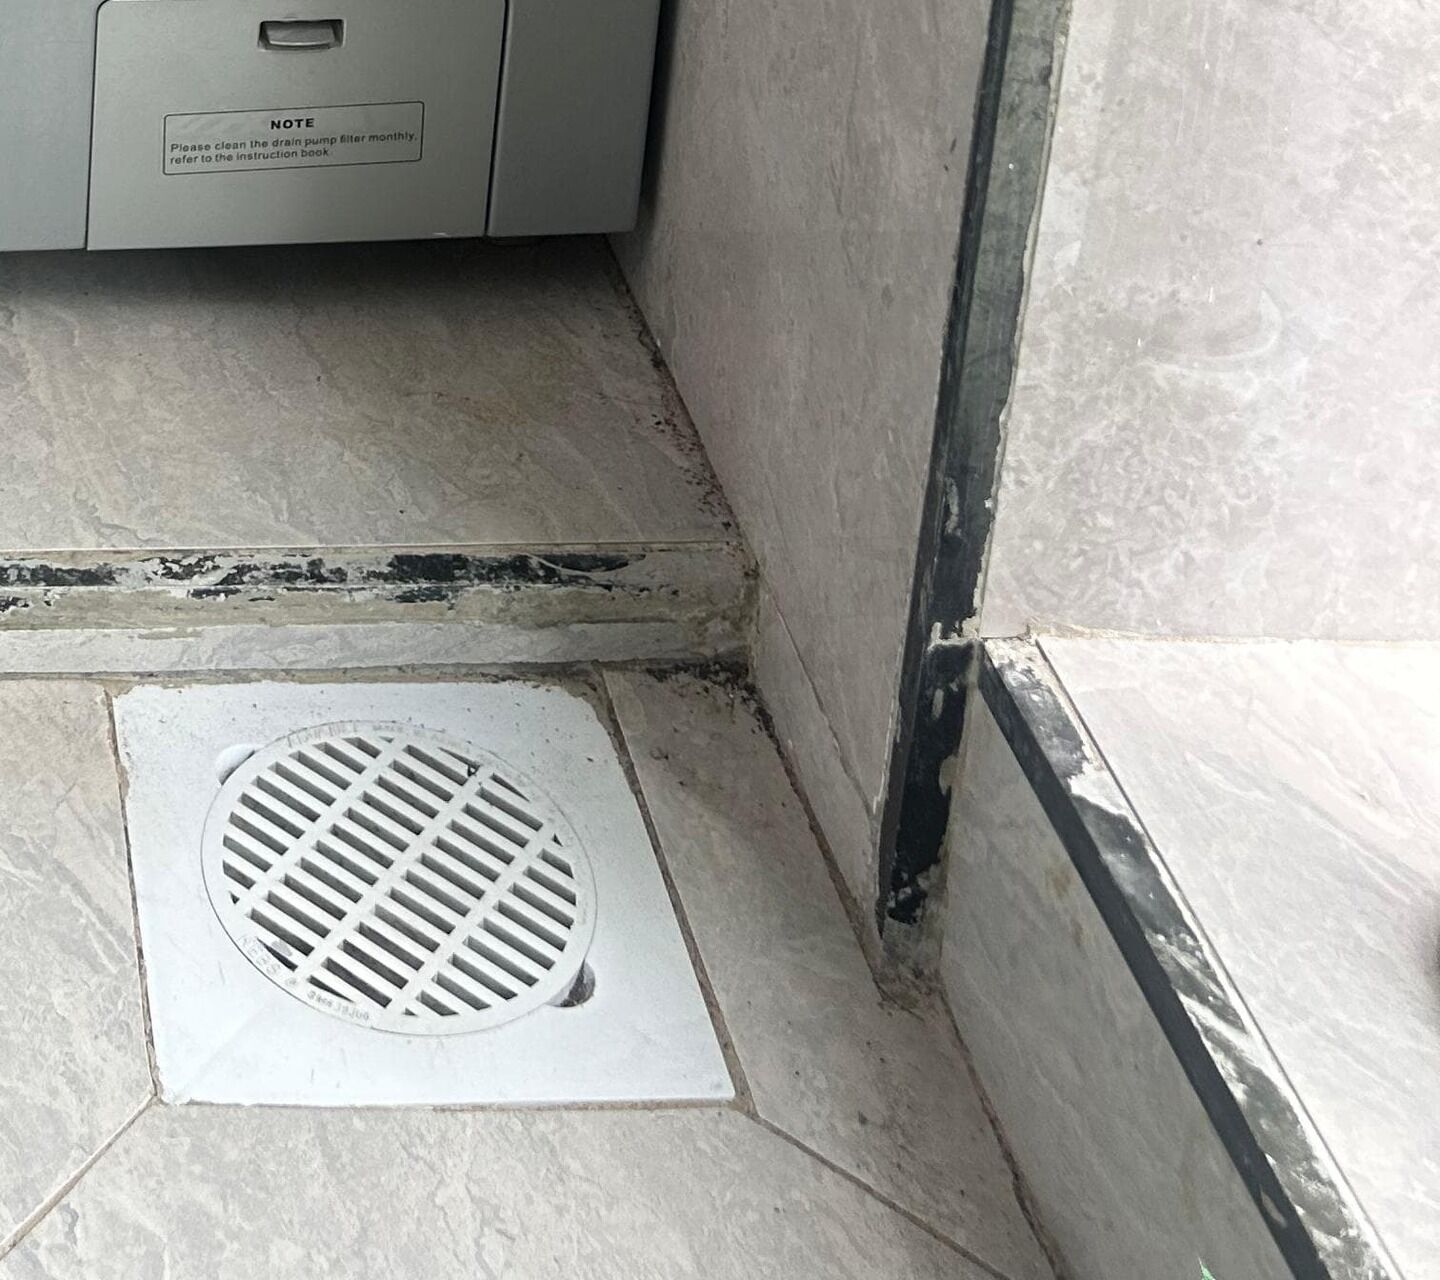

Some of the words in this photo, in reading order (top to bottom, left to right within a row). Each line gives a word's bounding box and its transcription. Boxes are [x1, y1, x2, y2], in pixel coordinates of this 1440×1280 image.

[271, 118, 314, 129] NOTE
[171, 144, 211, 152] Please
[215, 142, 246, 150] clean
[250, 140, 268, 148] the
[272, 138, 301, 147] drain
[305, 137, 337, 147] pump
[340, 135, 365, 143] filter
[171, 155, 198, 164] refer
[201, 155, 212, 163] to
[215, 153, 233, 162] the
[237, 151, 297, 160] instruction
